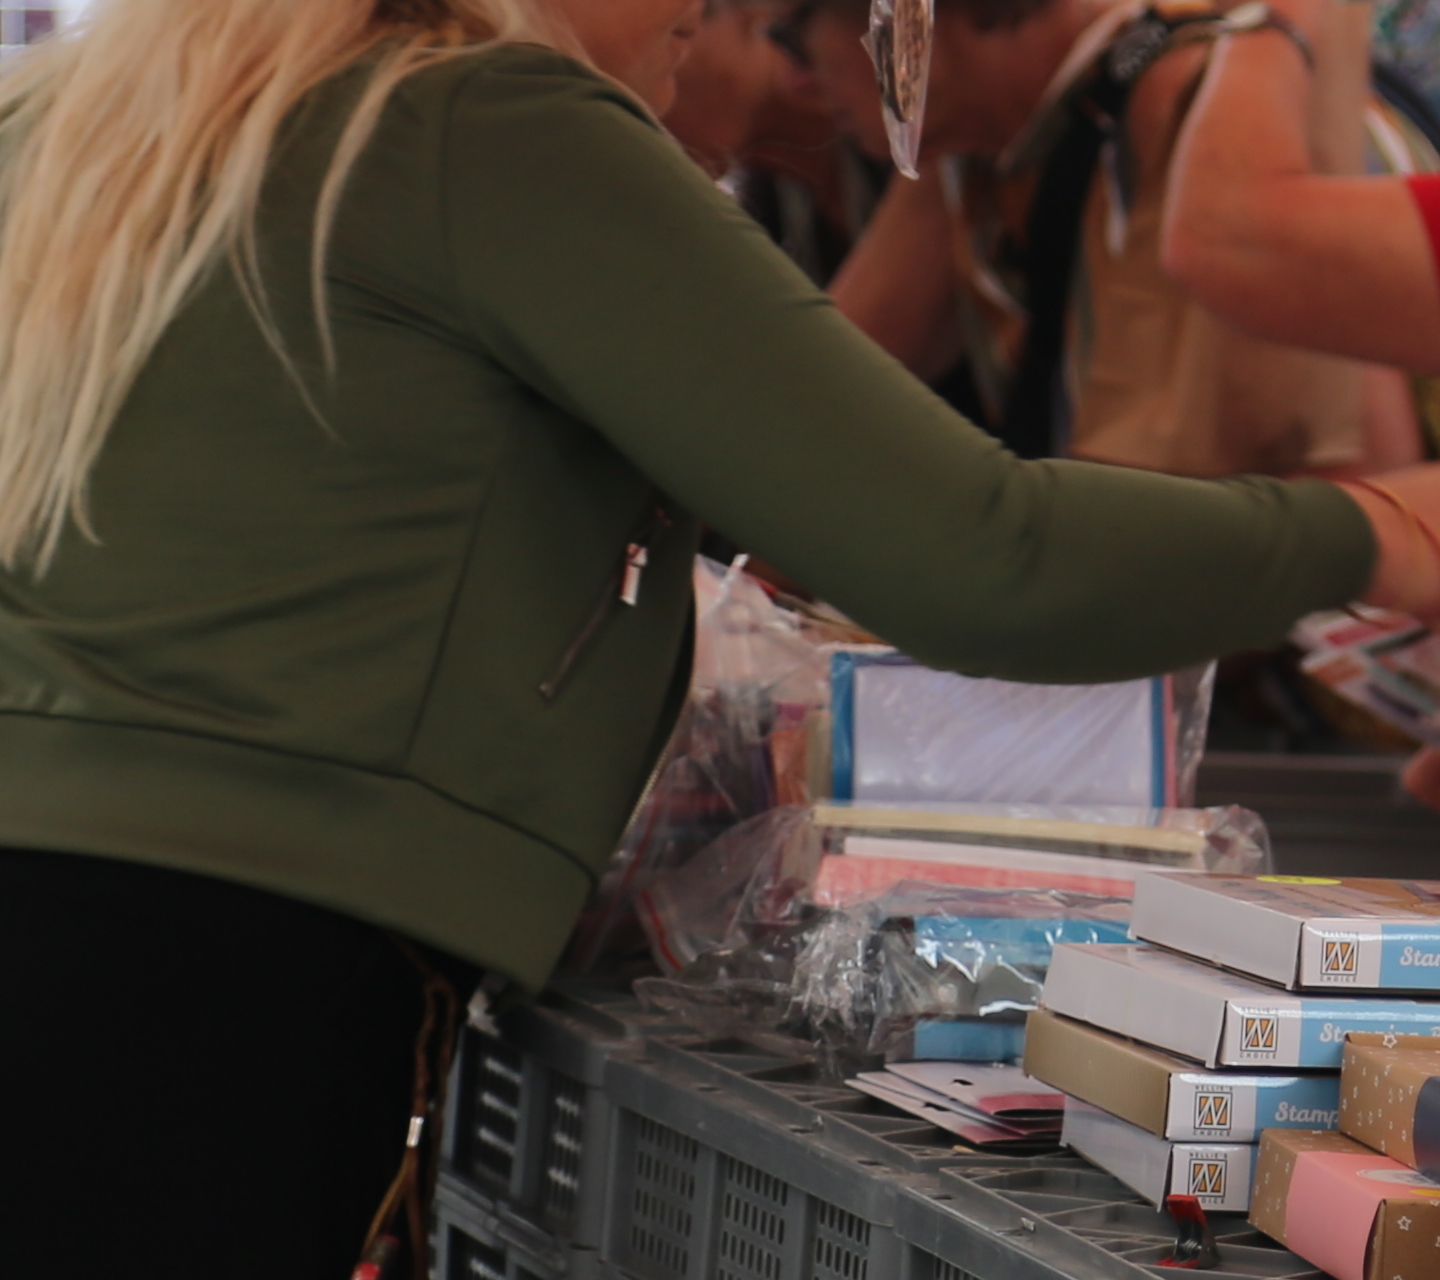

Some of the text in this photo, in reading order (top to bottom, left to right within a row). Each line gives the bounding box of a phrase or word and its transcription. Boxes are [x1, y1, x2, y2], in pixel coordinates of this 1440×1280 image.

[1319, 975, 1357, 983] CHOICE
[1239, 1051, 1278, 1060] CHOICE
[1195, 1084, 1233, 1092] NELLIE'S
[1193, 1129, 1230, 1137] CHOICE
